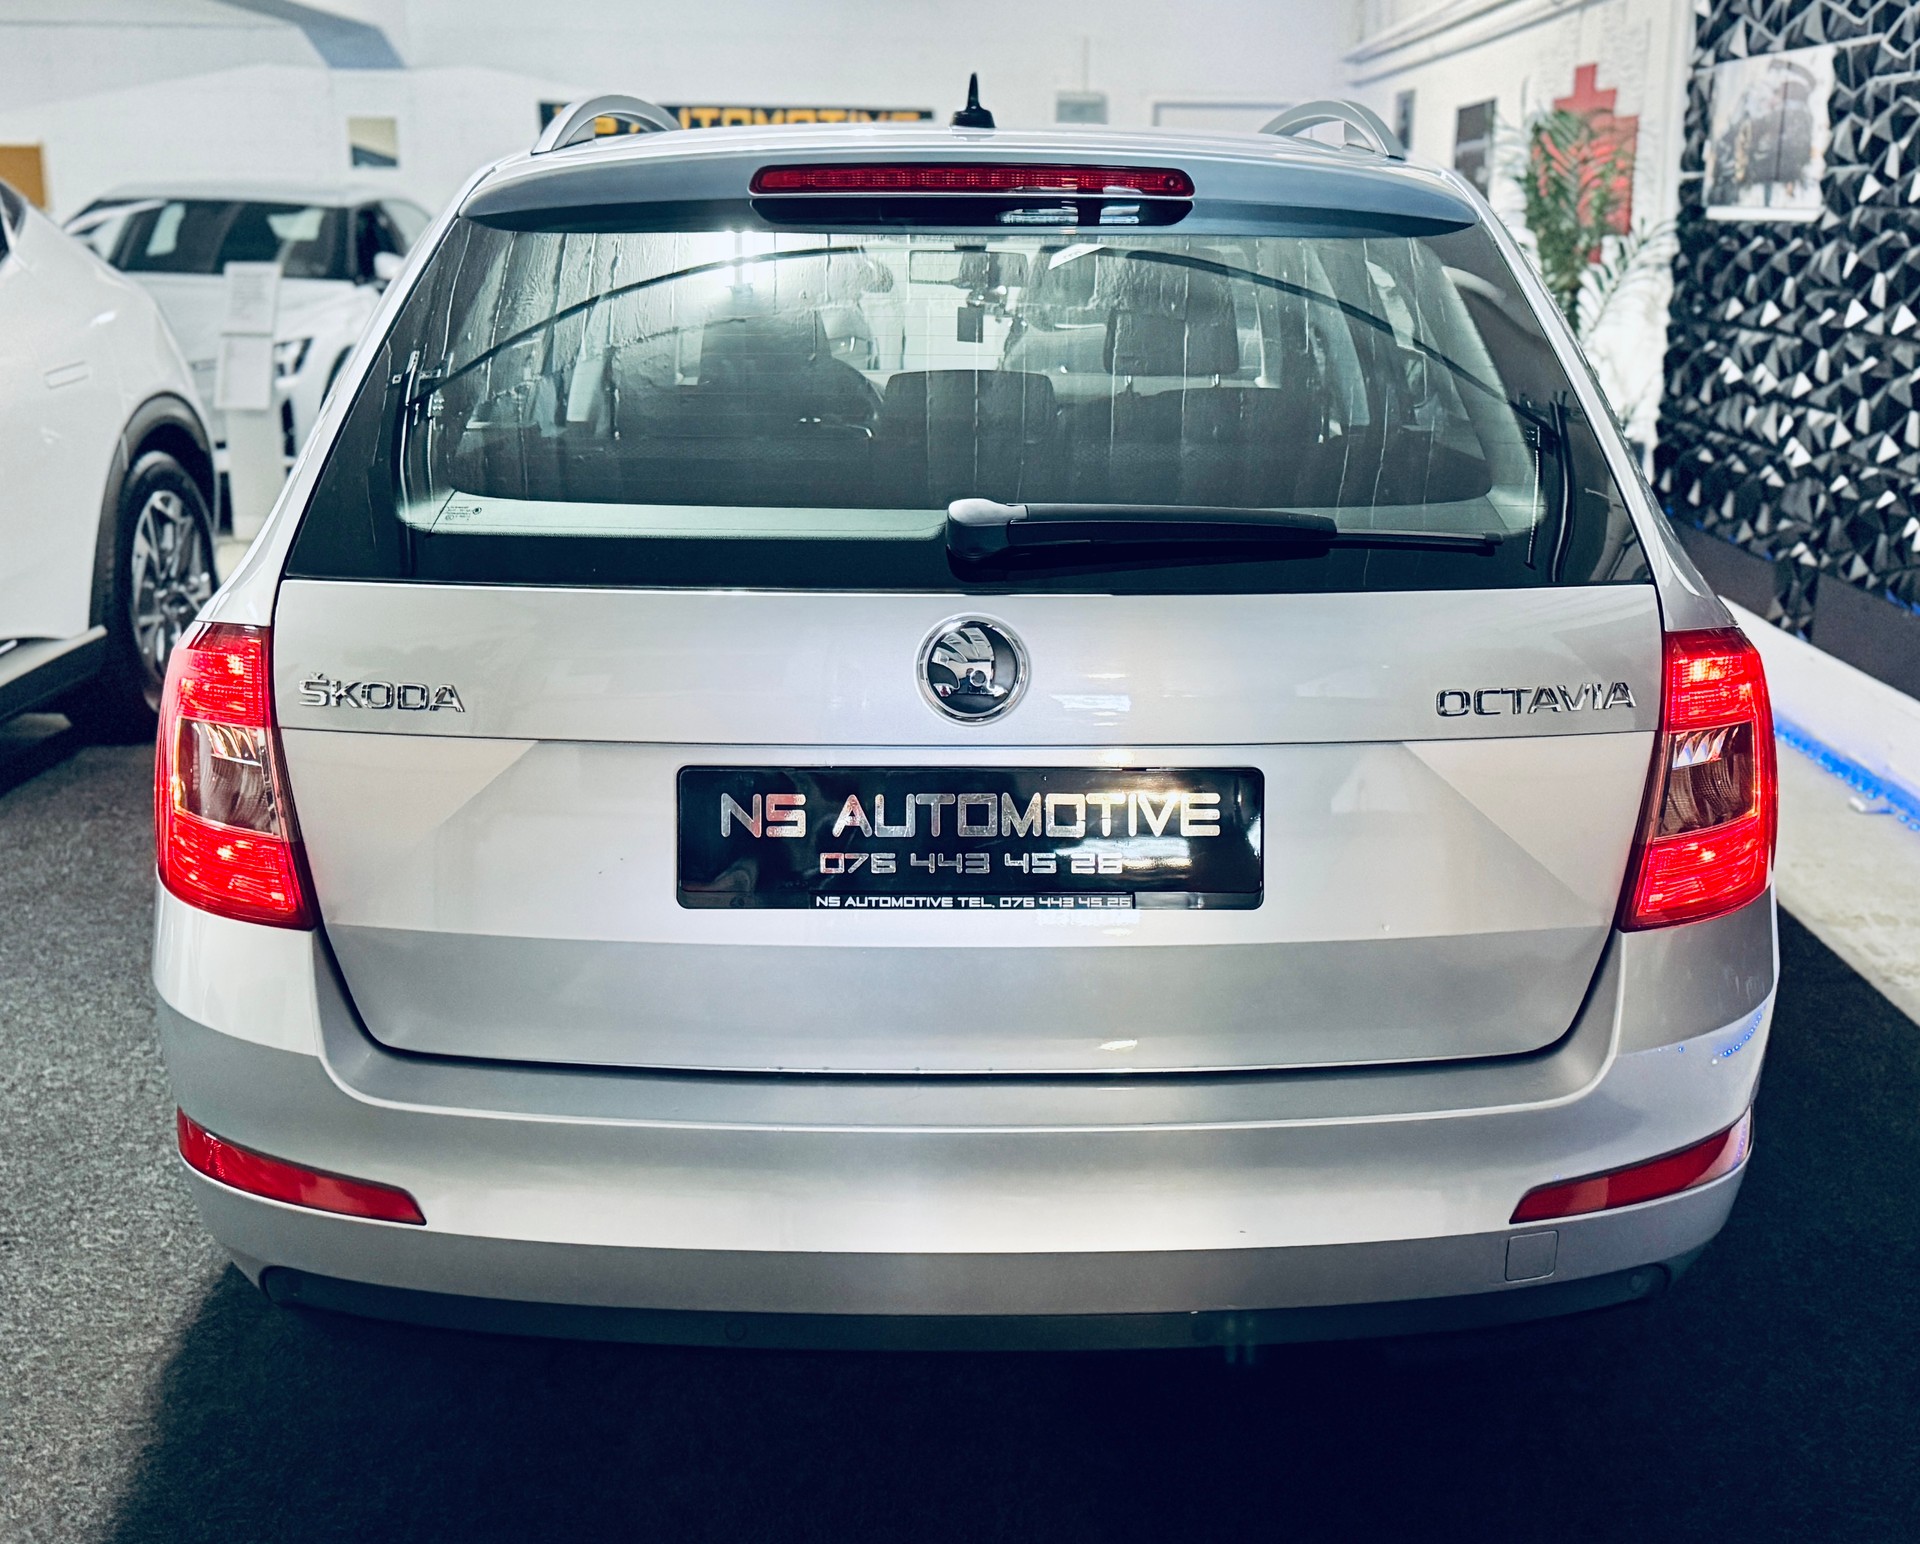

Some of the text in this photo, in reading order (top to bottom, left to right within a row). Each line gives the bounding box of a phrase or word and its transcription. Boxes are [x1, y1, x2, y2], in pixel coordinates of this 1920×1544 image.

[299, 671, 466, 713] ŠKODA
[1436, 682, 1637, 717] OCTAVIA
[721, 793, 1221, 838] NS AUTOMOTIVE
[819, 852, 1123, 874] 076 443 45 26
[816, 896, 841, 907] NS
[844, 896, 953, 907] AUTOMOTIVE
[999, 896, 1035, 908] 076
[1039, 896, 1074, 908] 443
